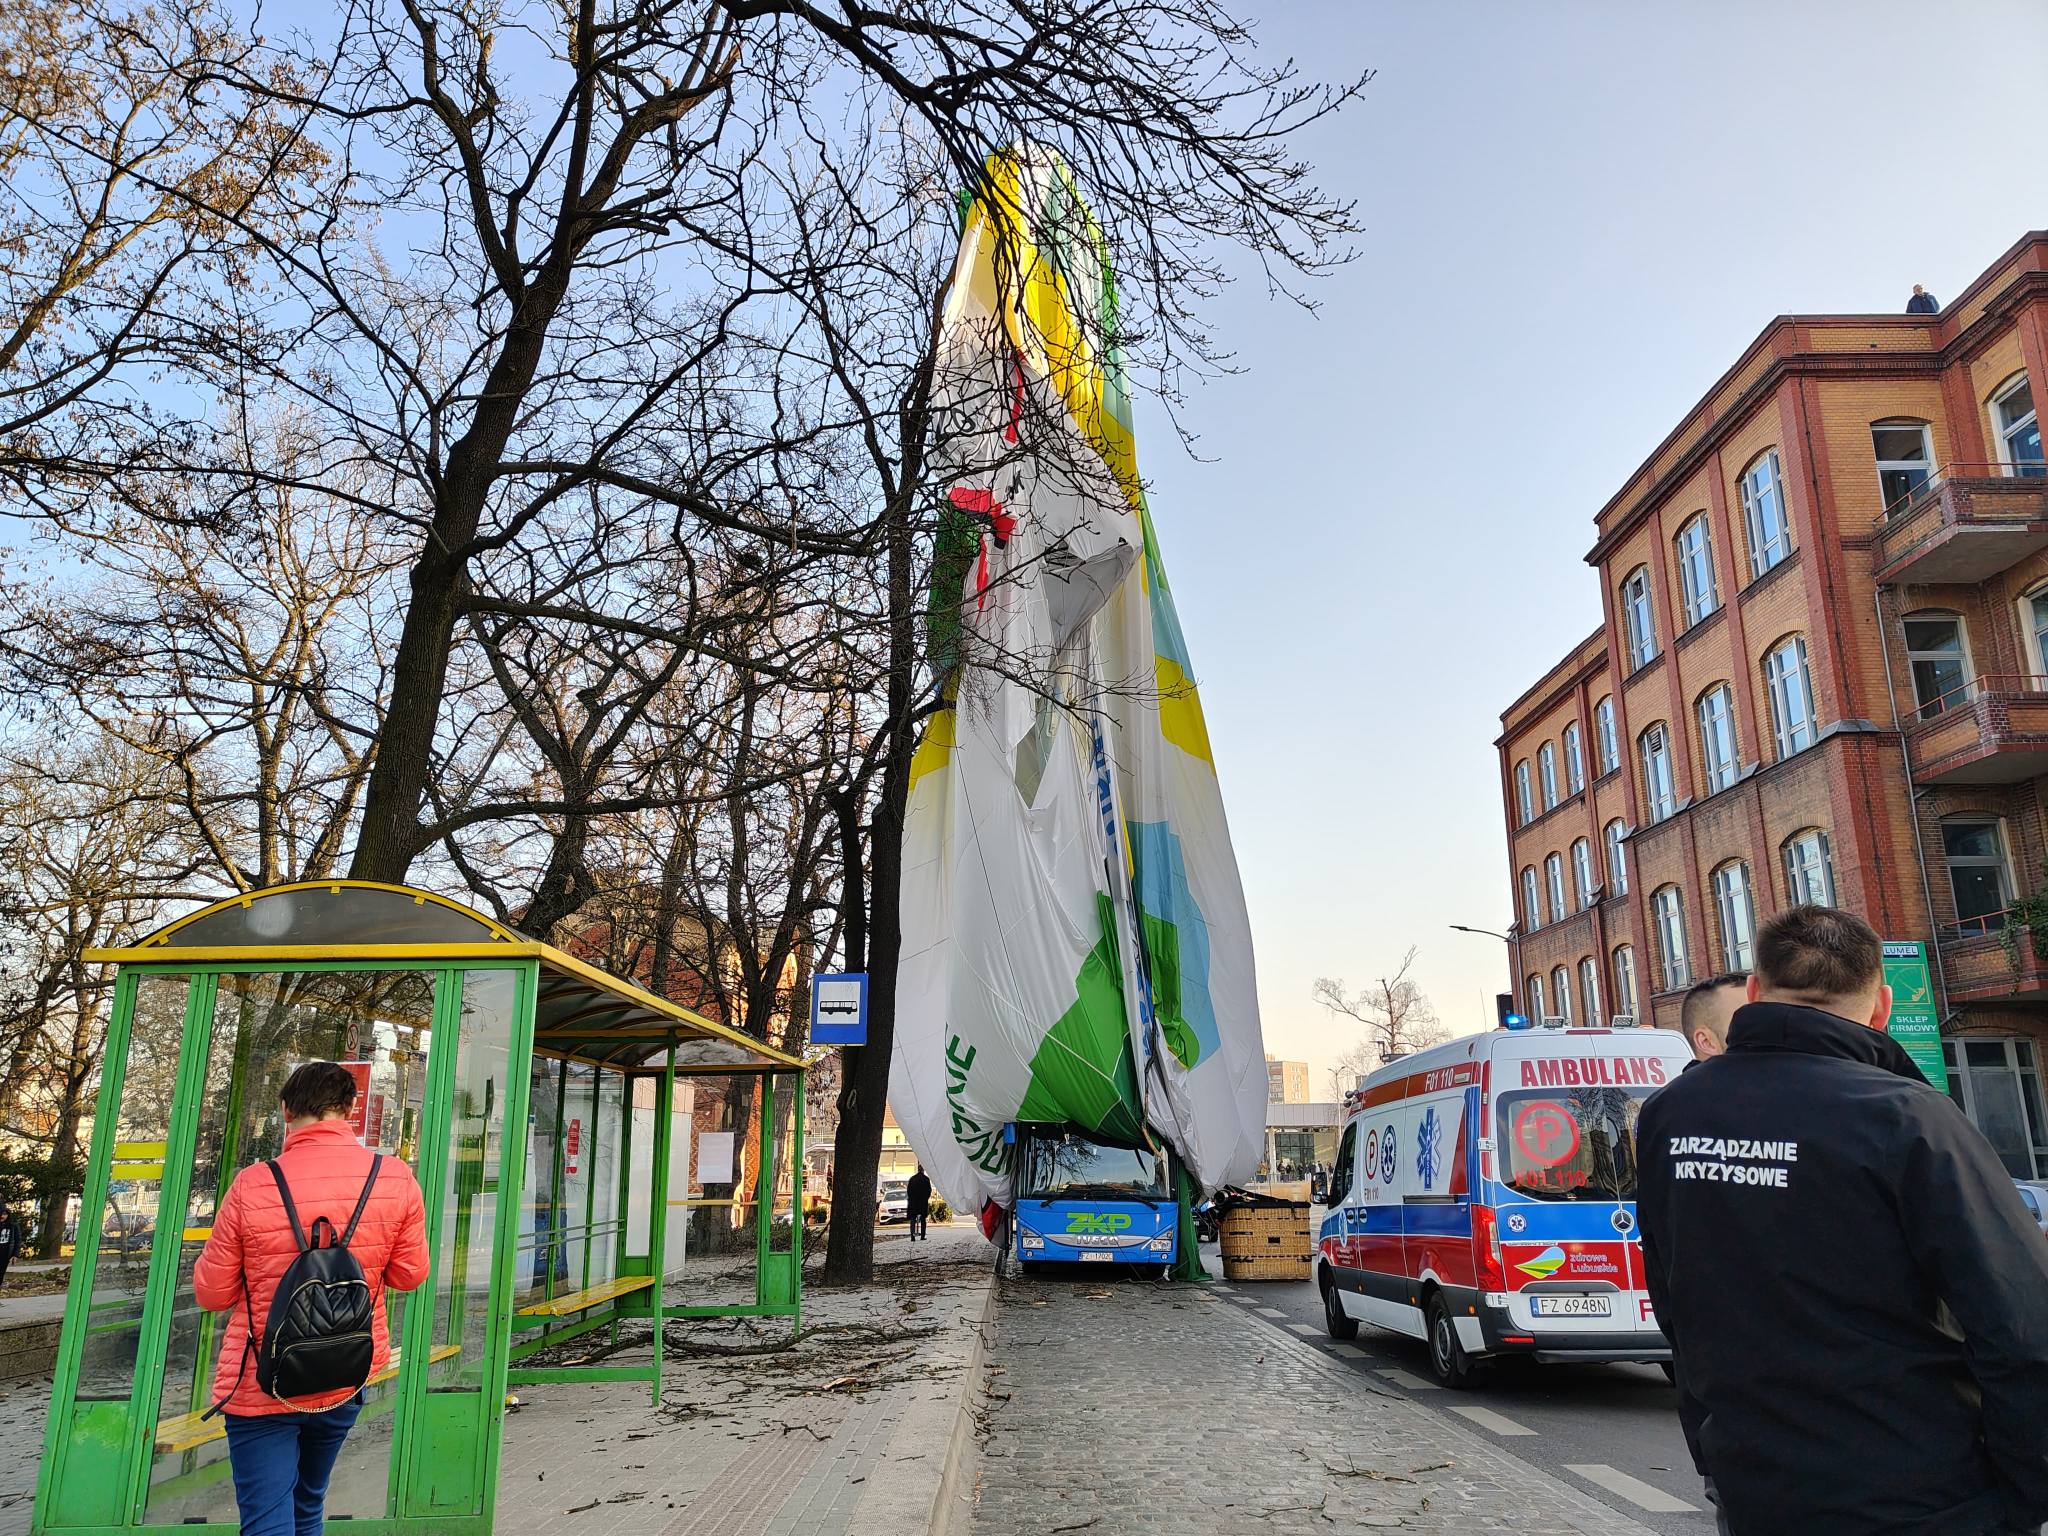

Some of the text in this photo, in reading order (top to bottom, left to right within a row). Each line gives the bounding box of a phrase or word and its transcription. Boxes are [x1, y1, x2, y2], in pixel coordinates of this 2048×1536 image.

[1885, 946, 1917, 954] LUMEL
[1890, 1024, 1937, 1032] FIRMOWY
[1425, 1068, 1454, 1092] F01 110
[1520, 1057, 1666, 1087] AMBULANS
[1535, 1116, 1562, 1152] P
[1369, 1141, 1375, 1170] P
[1670, 1136, 1798, 1161] ZARZĄDZANIE
[1554, 1168, 1587, 1187] 110
[1675, 1161, 1788, 1187] KRYZYSOWE
[1066, 1212, 1131, 1234] ZKP
[1076, 1235, 1119, 1245] IVECO
[1569, 1253, 1607, 1263] zdrowe
[1569, 1263, 1619, 1273] Lubuskie
[1540, 1299, 1607, 1313] FZ 6948N
